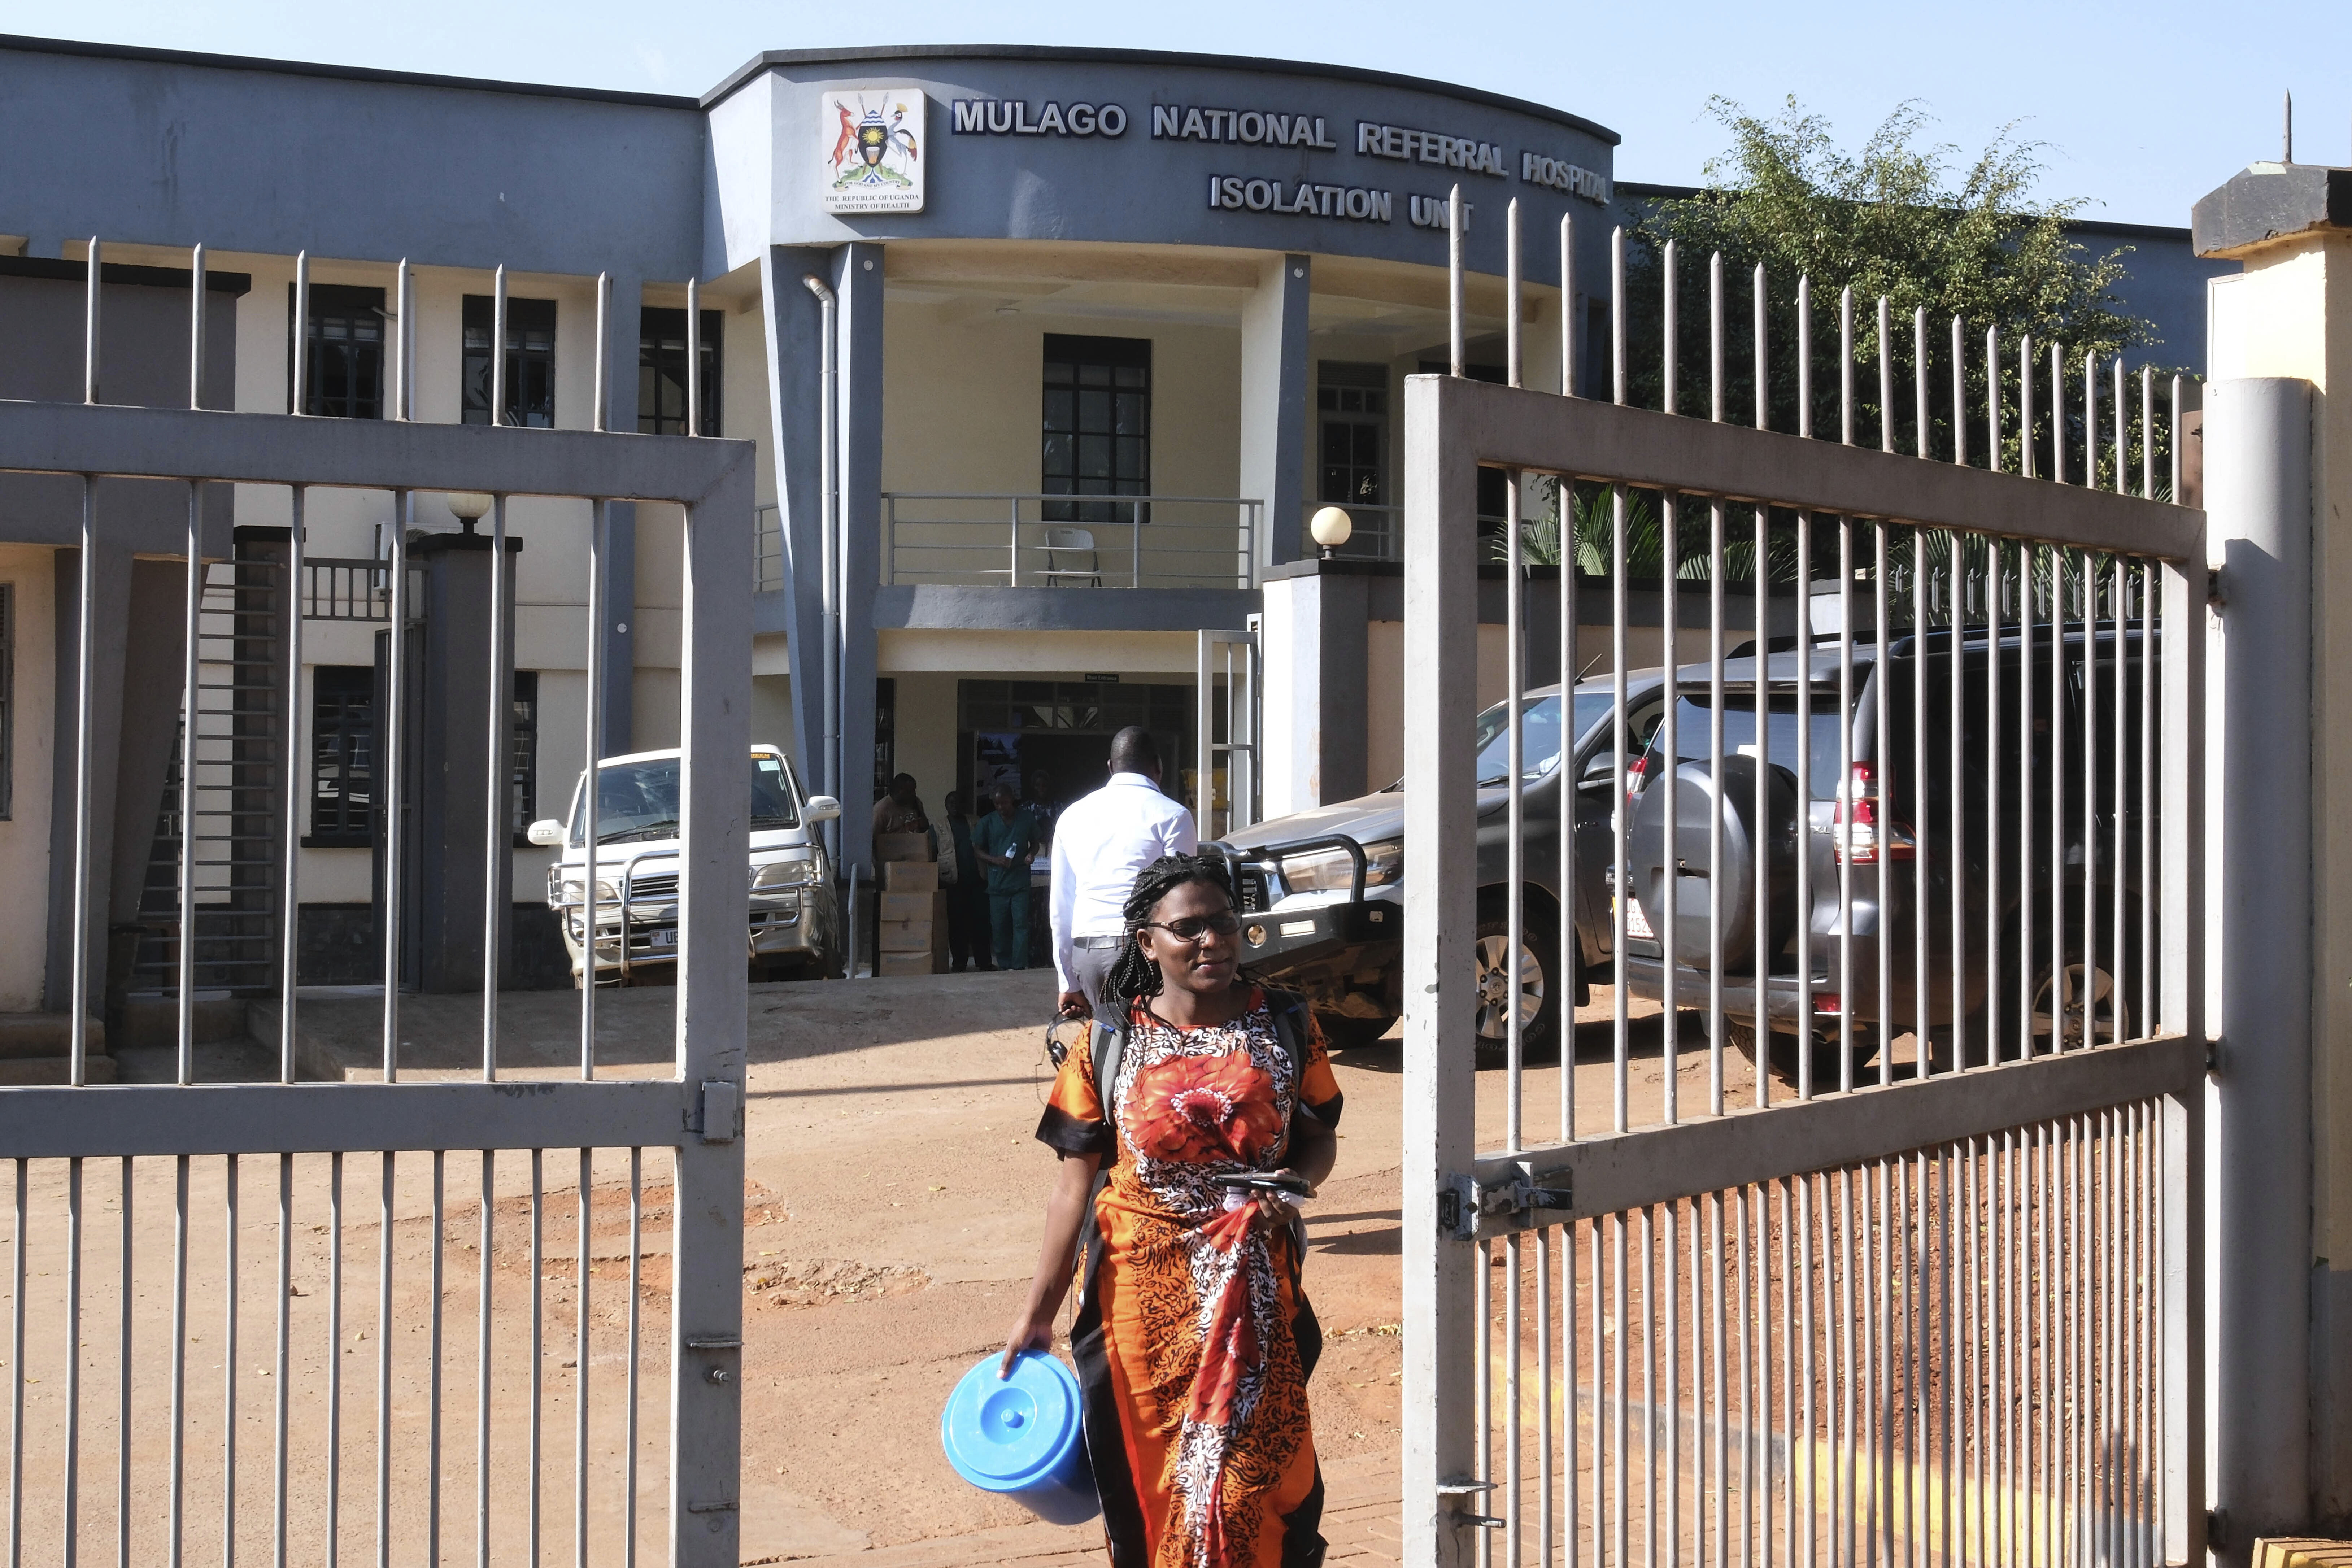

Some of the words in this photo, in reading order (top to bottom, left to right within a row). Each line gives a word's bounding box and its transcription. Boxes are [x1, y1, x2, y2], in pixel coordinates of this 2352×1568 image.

[954, 101, 1128, 136] MULAGO
[1154, 105, 1336, 148] NATIONAL
[1357, 122, 1510, 177] REFERRAL
[1522, 152, 1610, 205] HOSPITAL
[1211, 175, 1392, 221] ISOLATION
[1410, 195, 1474, 231] UNT
